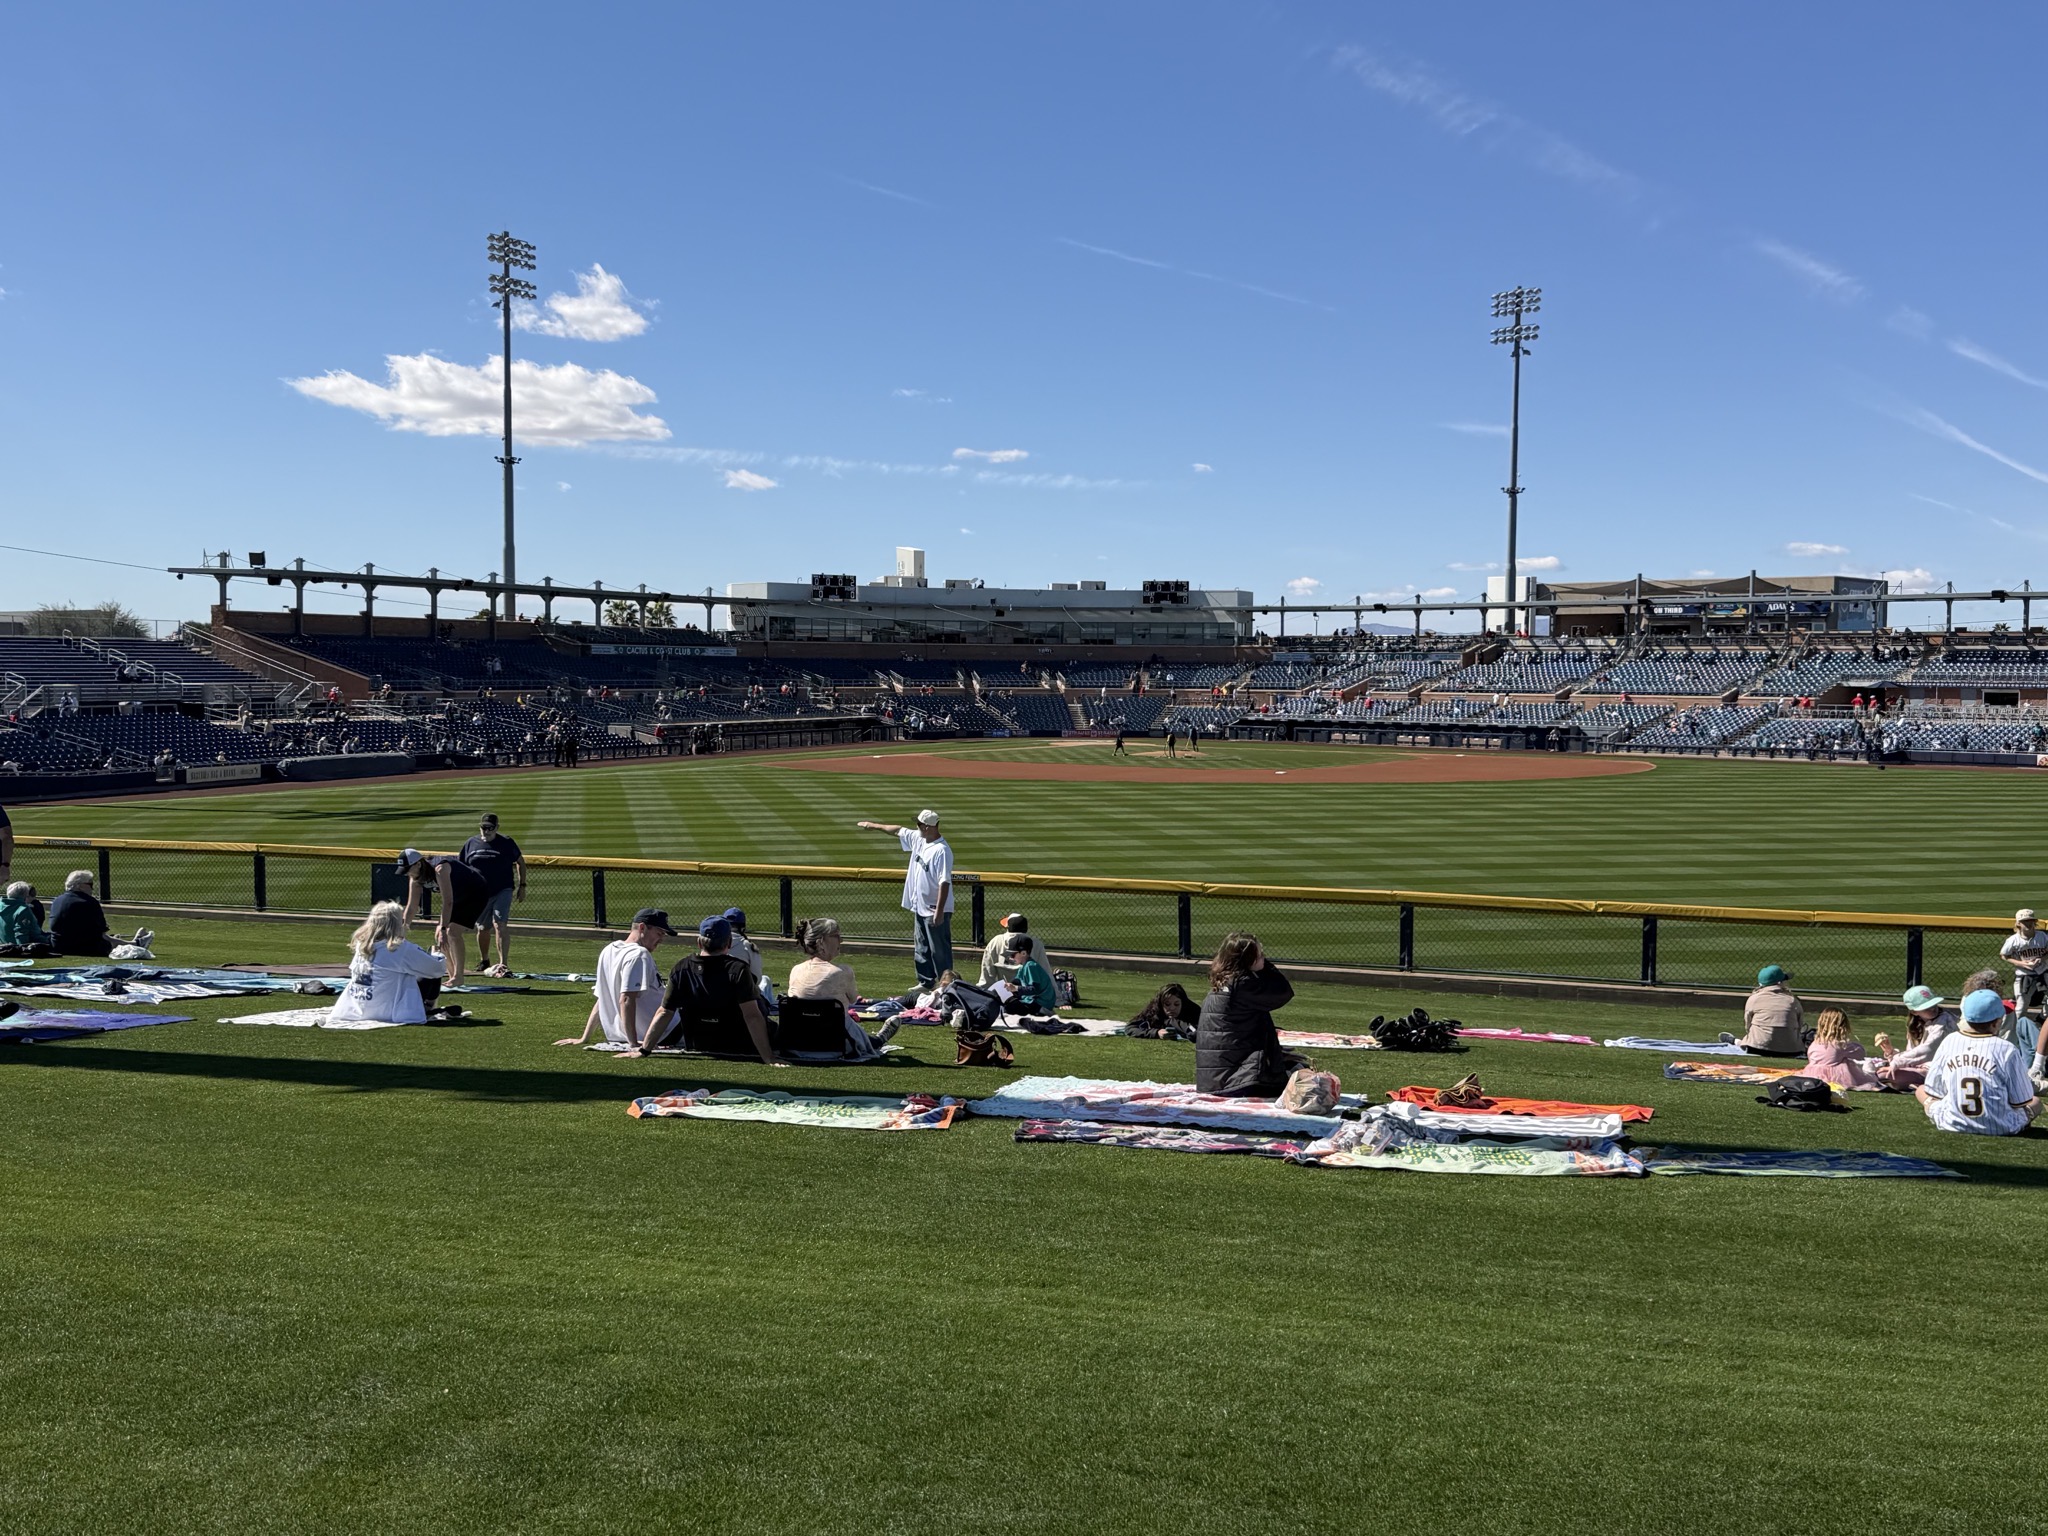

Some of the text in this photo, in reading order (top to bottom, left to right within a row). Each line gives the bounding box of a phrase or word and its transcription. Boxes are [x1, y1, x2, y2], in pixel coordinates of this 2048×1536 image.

[626, 646, 648, 655] CACTUS
[655, 647, 673, 655] COST
[674, 647, 691, 656] CLUB
[1947, 1054, 1997, 1075] MERRILL
[1961, 1077, 1983, 1117] 3
